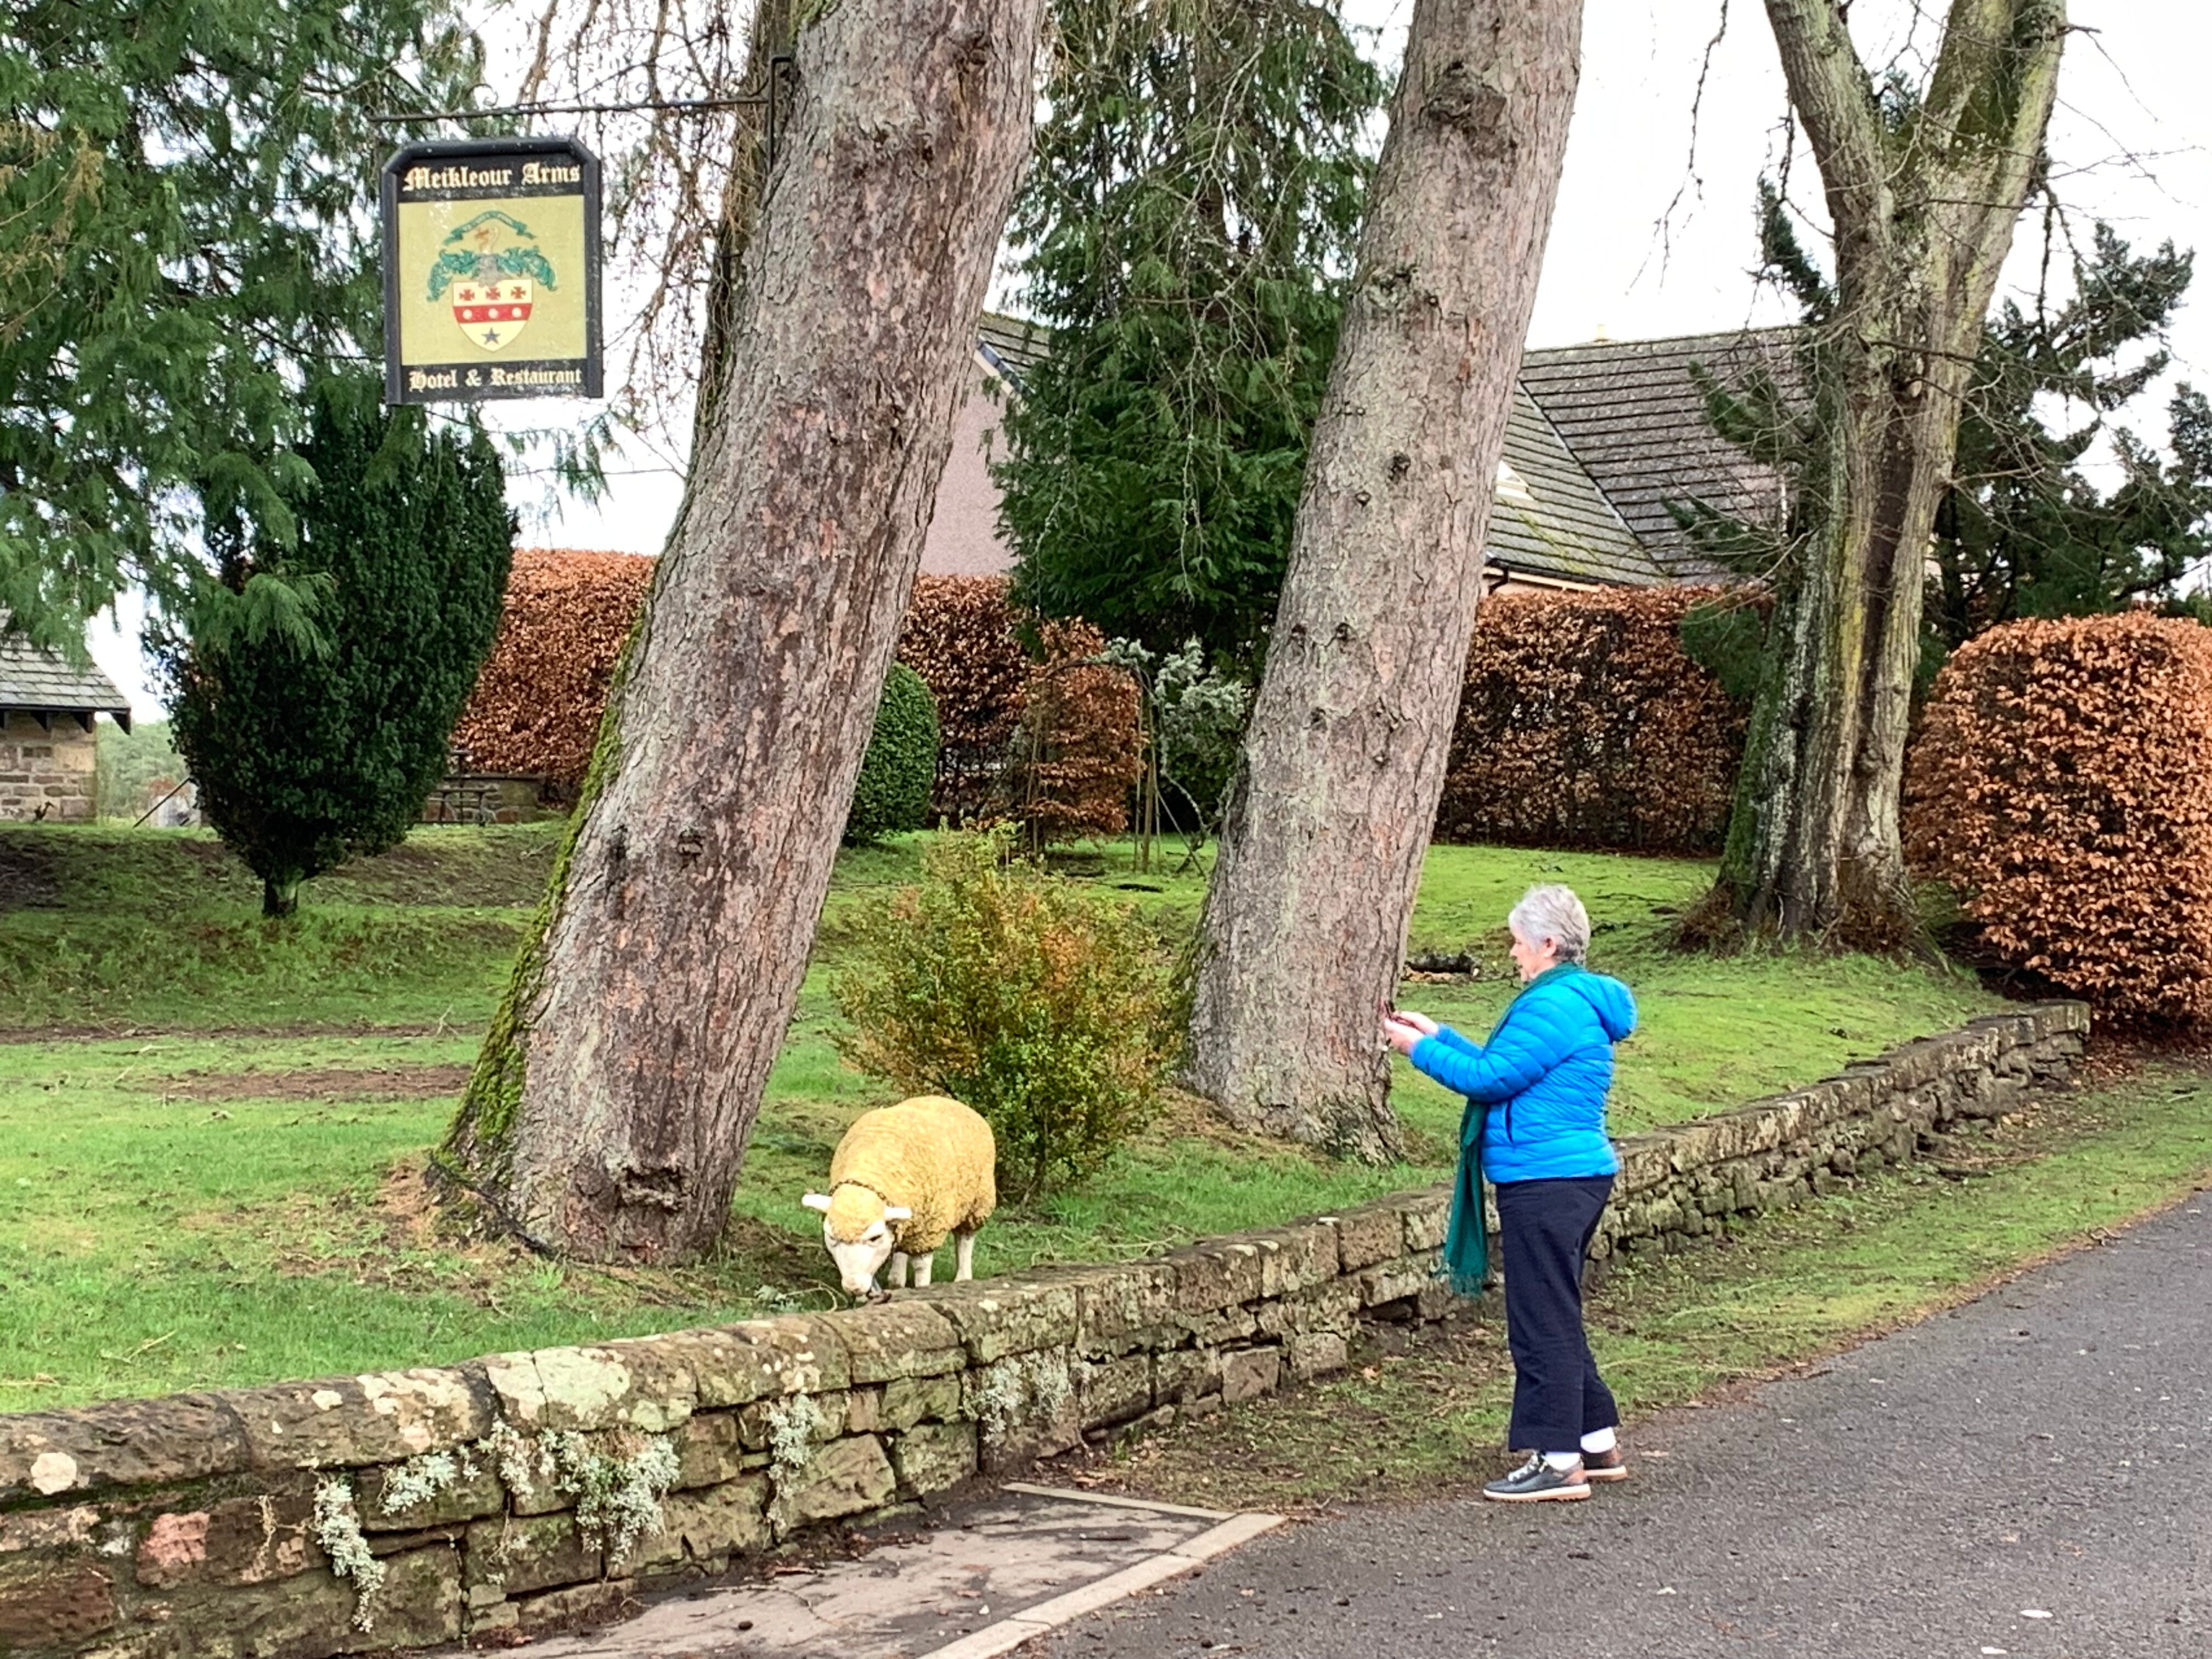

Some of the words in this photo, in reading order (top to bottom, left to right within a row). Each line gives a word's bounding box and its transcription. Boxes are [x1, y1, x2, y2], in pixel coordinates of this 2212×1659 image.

[402, 165, 512, 191] Meikleour
[521, 162, 580, 185] Arms
[409, 369, 459, 392] Hotel
[465, 369, 483, 387] &
[489, 367, 583, 386] Restaurant
